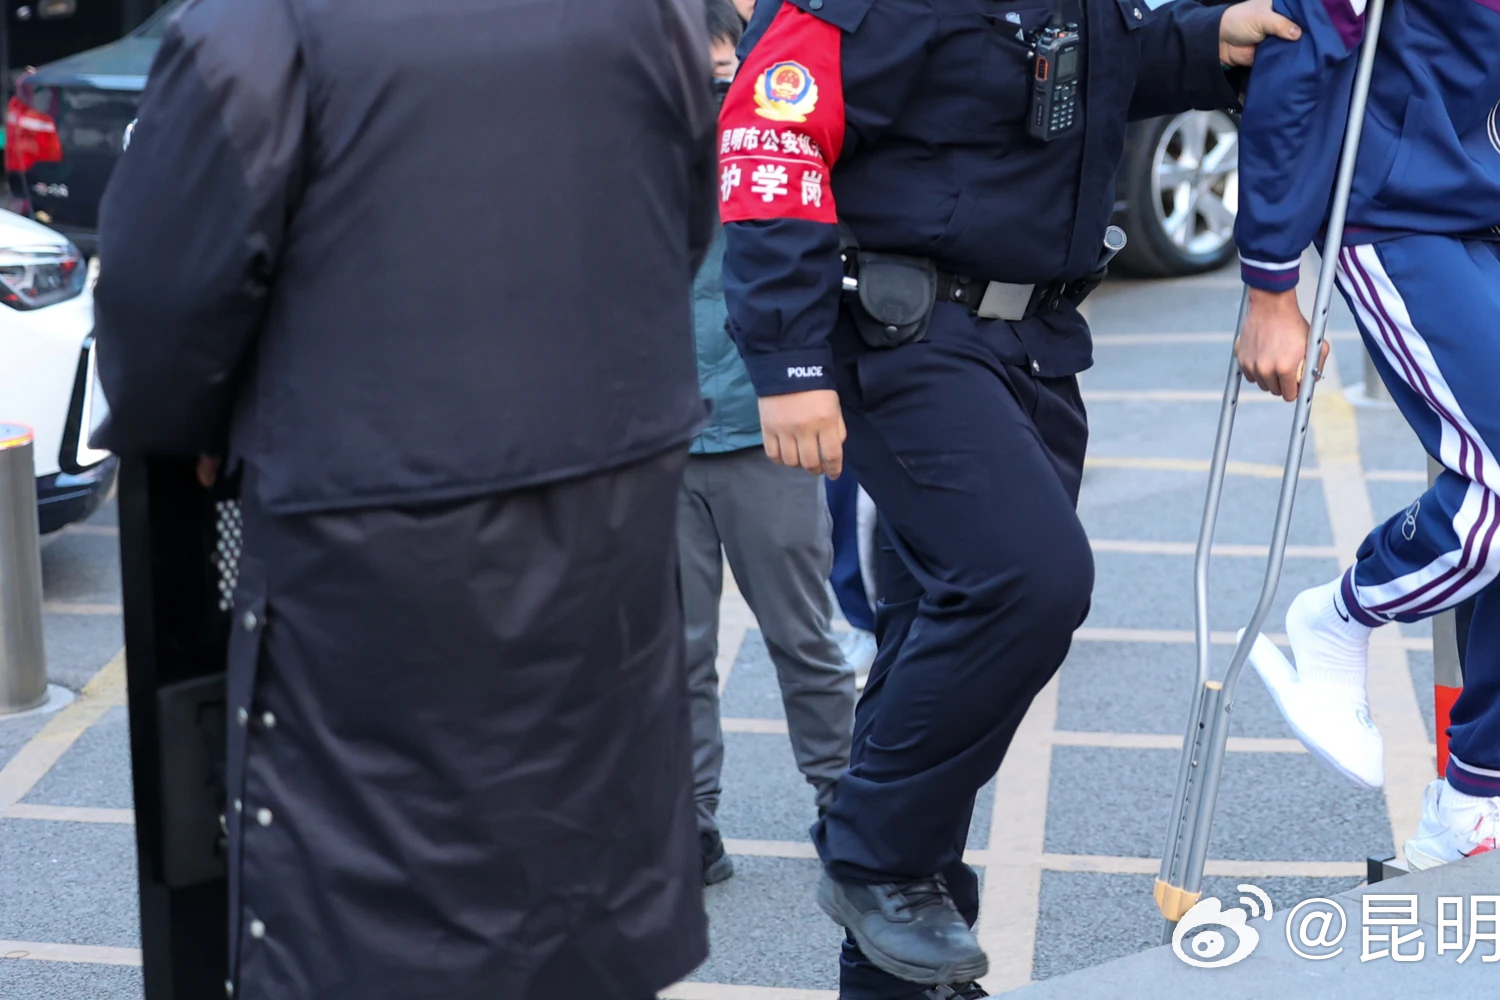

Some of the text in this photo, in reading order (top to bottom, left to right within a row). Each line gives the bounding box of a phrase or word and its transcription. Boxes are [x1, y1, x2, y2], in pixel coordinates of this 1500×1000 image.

[720, 163, 824, 208] 护学岗
[787, 365, 824, 378] POLICE
